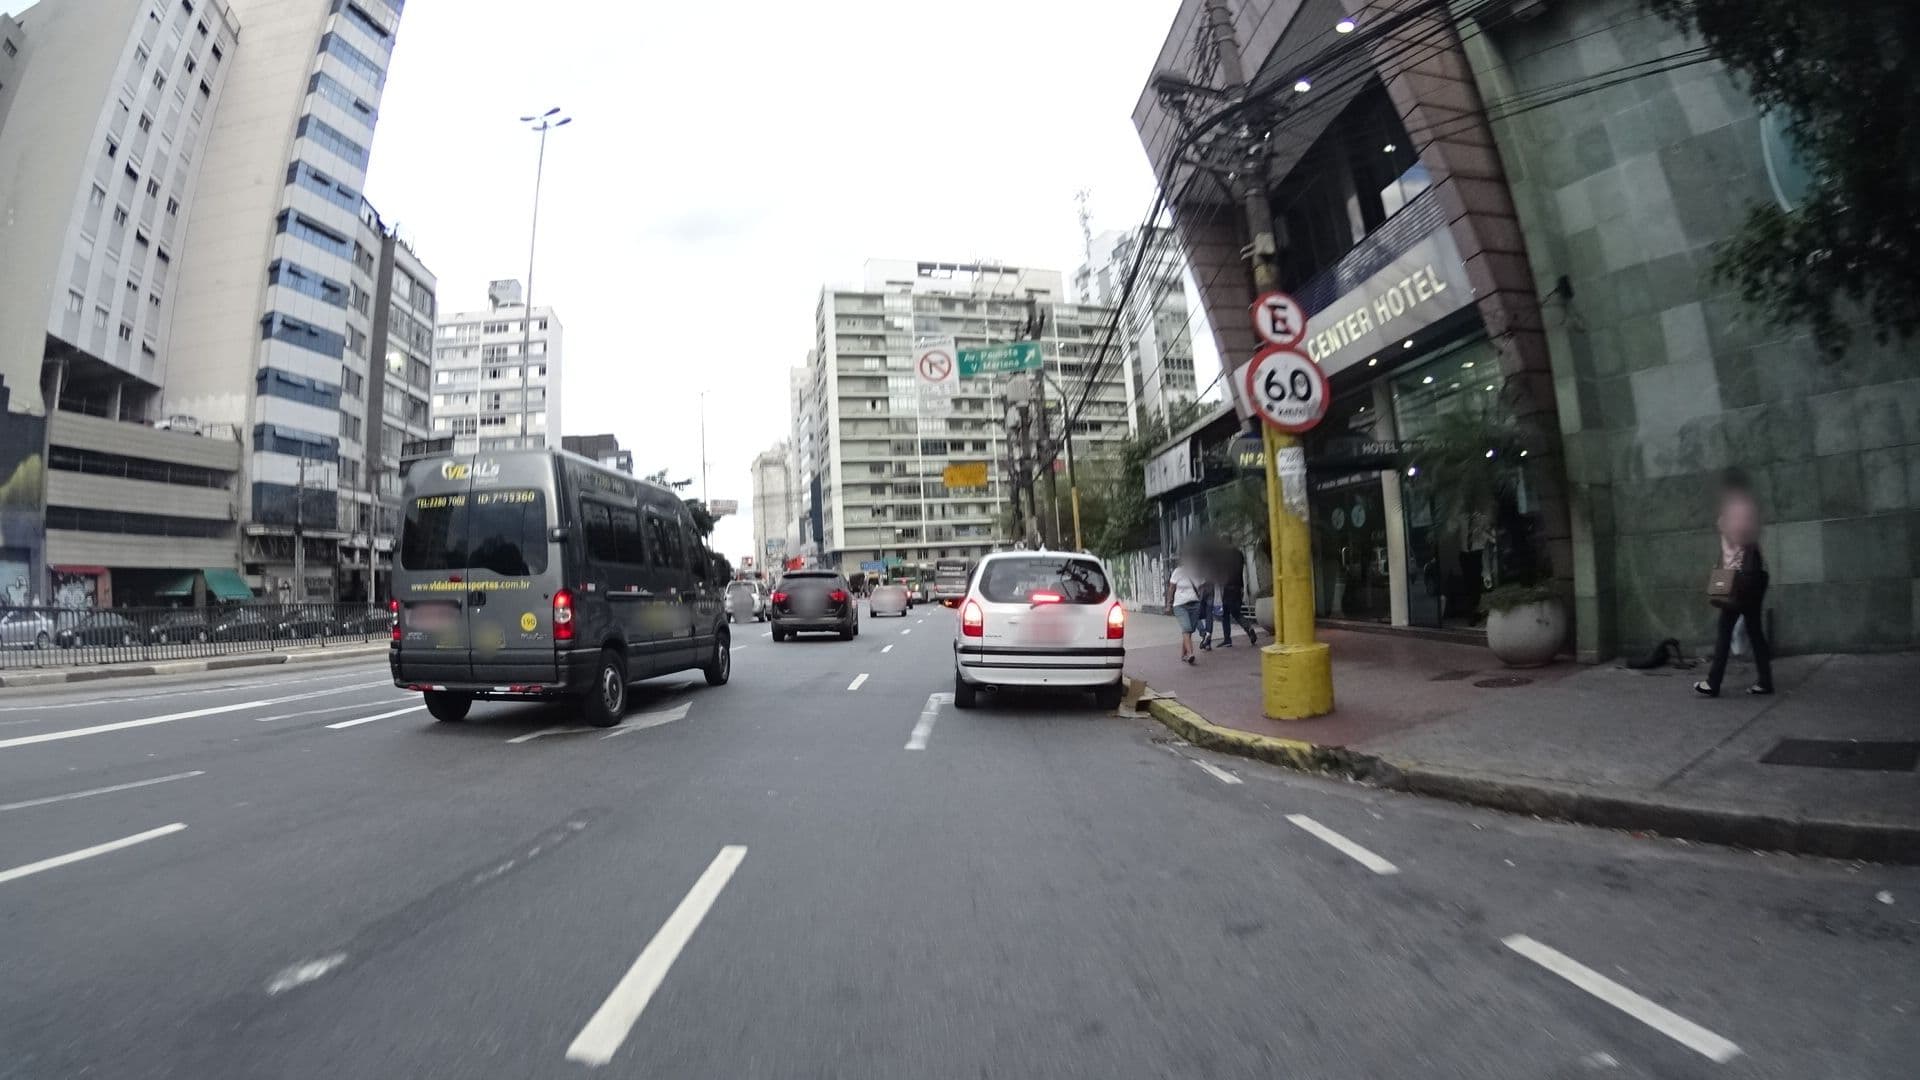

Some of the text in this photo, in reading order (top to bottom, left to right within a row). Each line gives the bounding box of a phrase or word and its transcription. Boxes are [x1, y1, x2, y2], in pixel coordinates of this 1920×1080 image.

[1267, 303, 1292, 335] E
[1307, 263, 1447, 364] CENTER HOTEL
[1264, 368, 1312, 402] 60
[1361, 441, 1399, 456] HOTEL
